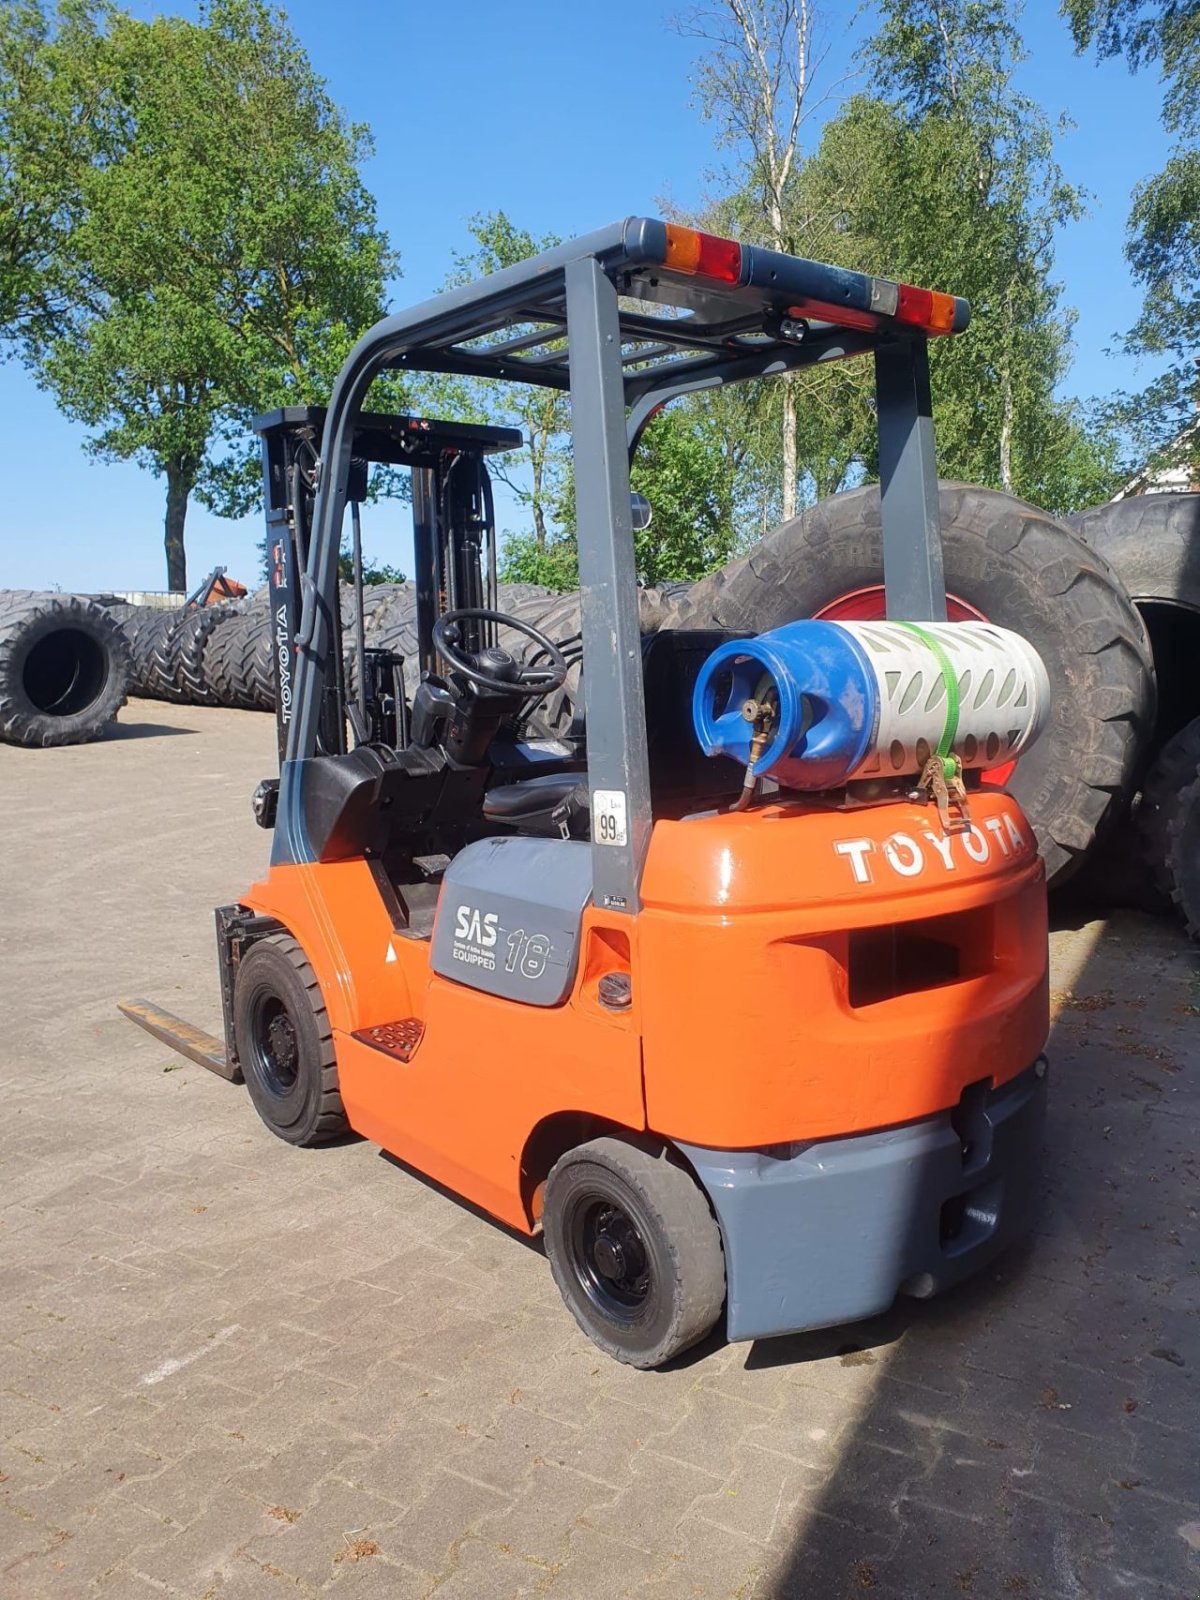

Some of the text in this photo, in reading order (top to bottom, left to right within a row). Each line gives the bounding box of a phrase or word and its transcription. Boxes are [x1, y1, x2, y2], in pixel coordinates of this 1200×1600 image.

[276, 604, 292, 724] TOYOTA
[600, 814, 616, 840] 99
[835, 811, 1026, 884] TOYOTA
[454, 905, 499, 947] SAS
[453, 948, 496, 971] EQUIPPED
[505, 929, 550, 979] 18
